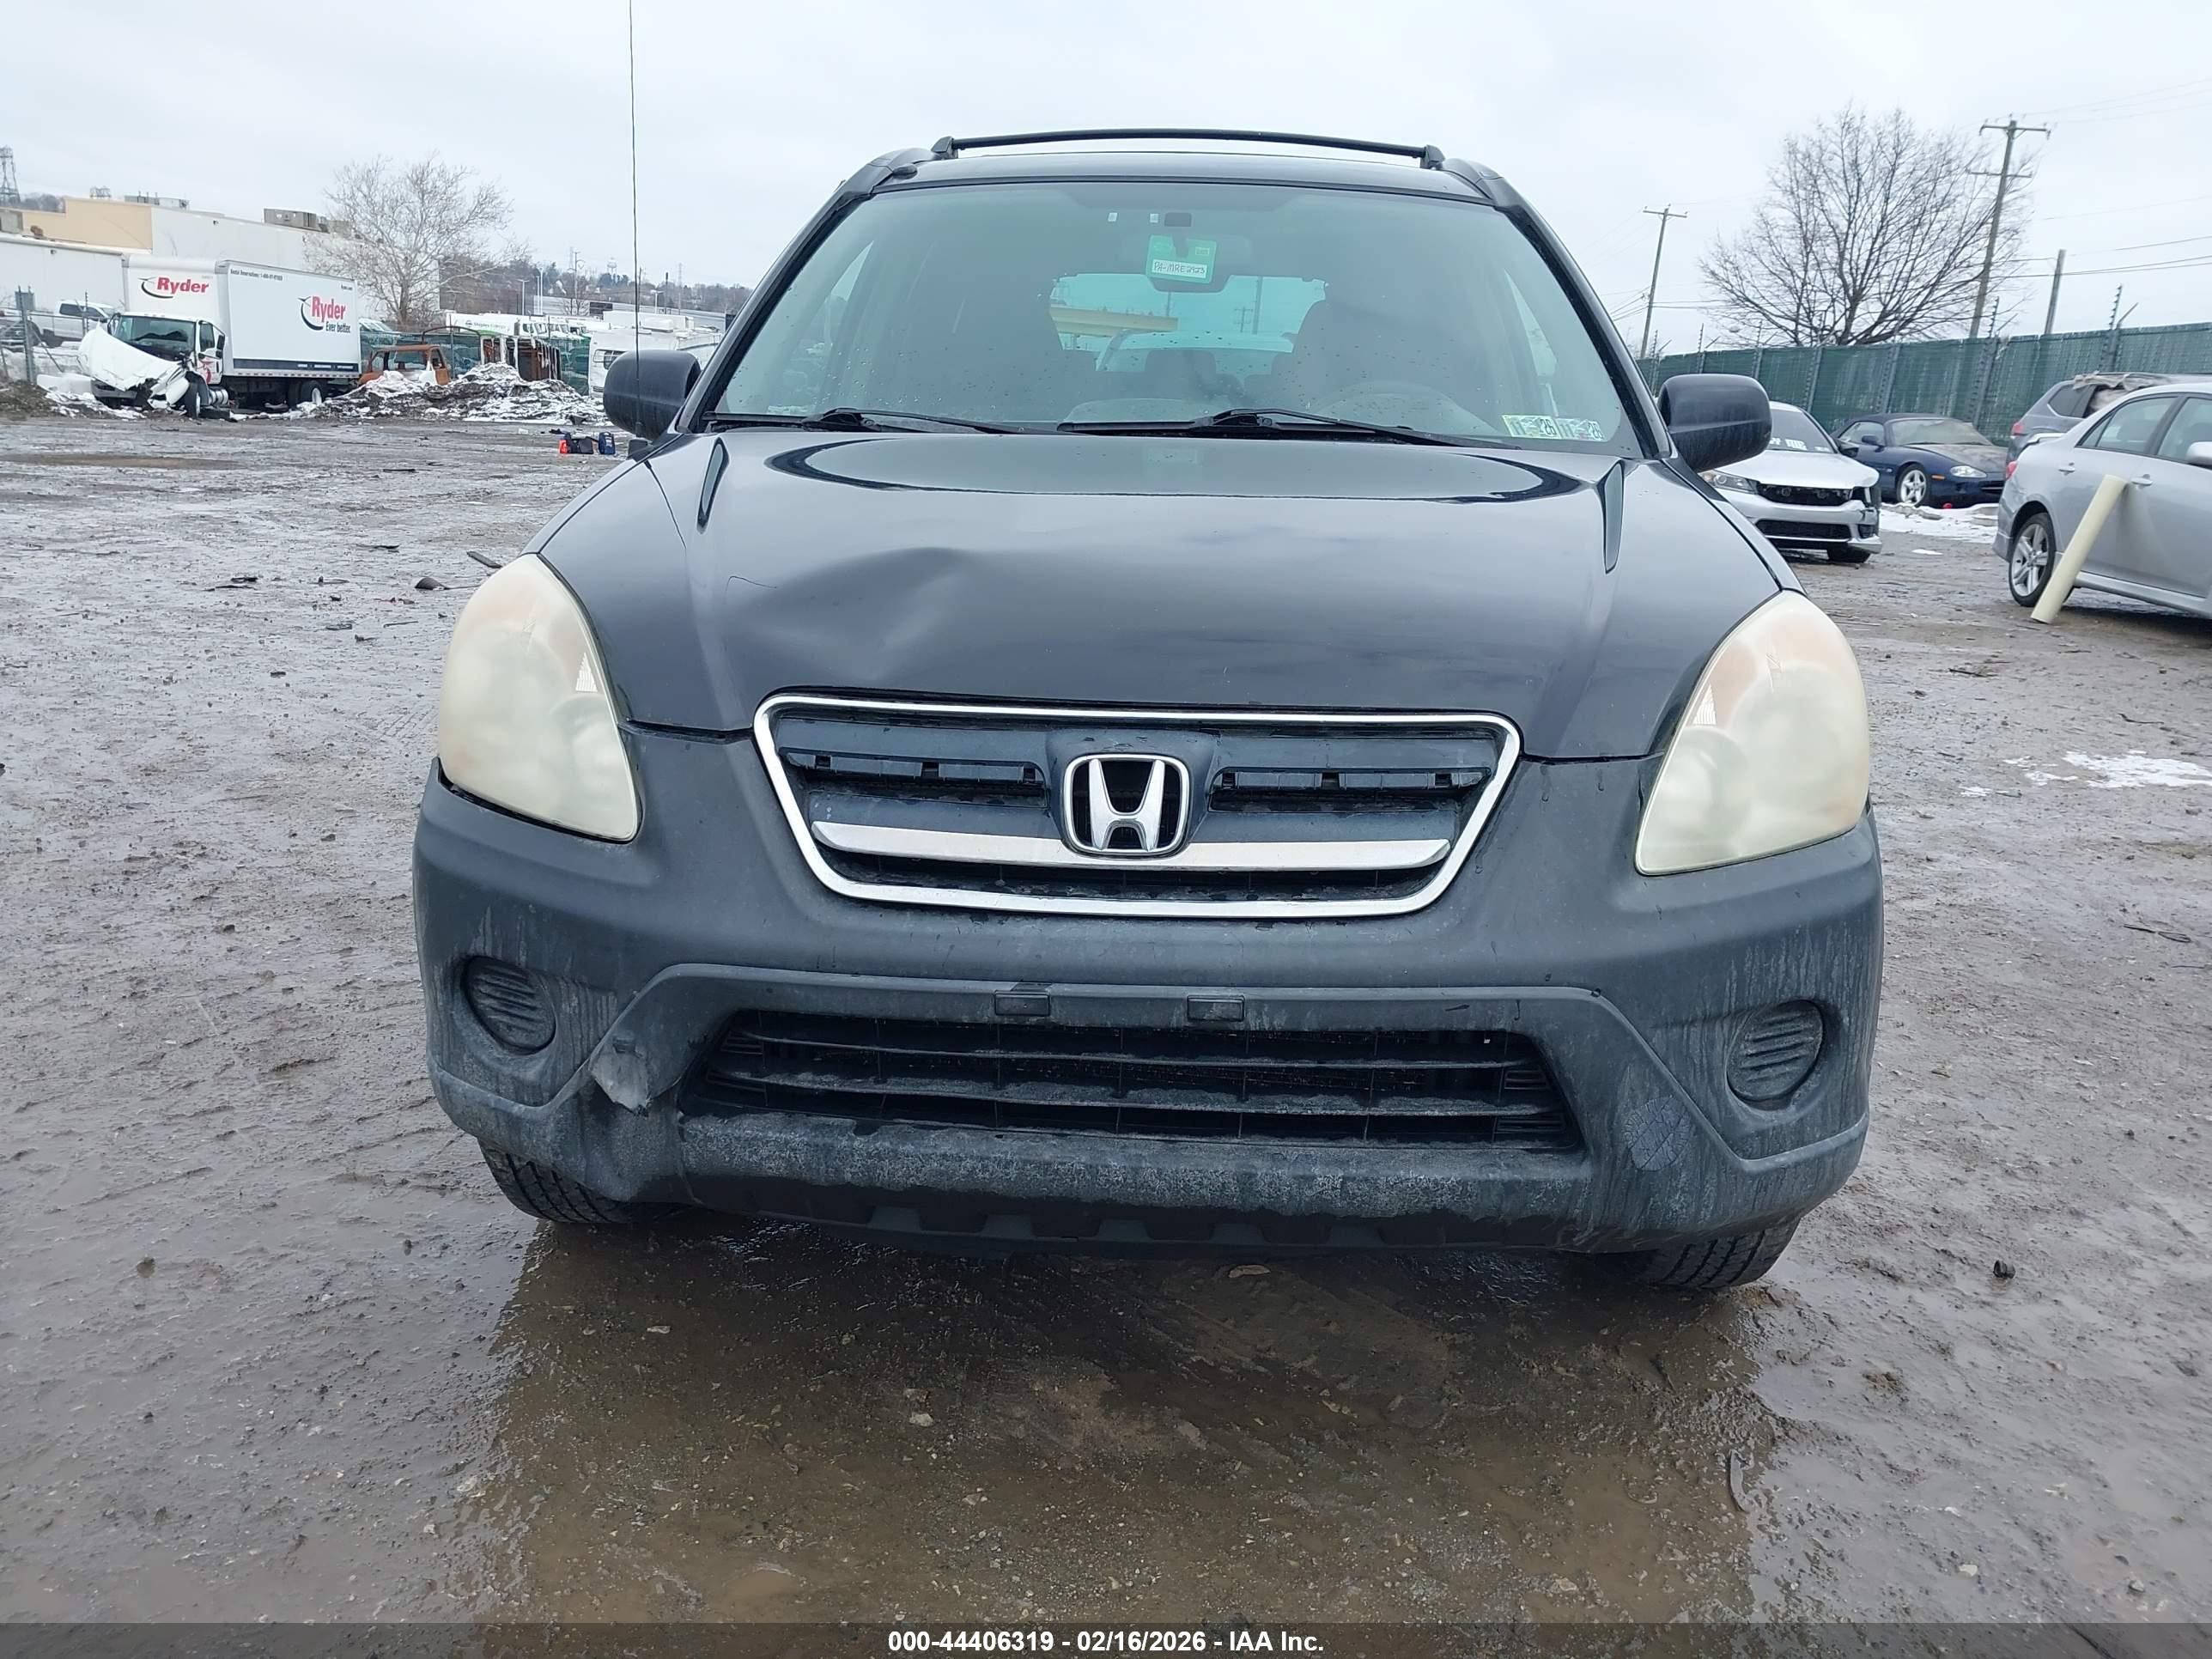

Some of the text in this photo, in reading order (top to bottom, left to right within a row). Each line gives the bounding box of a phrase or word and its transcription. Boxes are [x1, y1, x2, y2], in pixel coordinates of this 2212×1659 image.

[157, 276, 210, 295] Ryder
[312, 295, 345, 322] Ryder
[325, 321, 336, 332] Ever
[1539, 418, 1557, 435] 26
